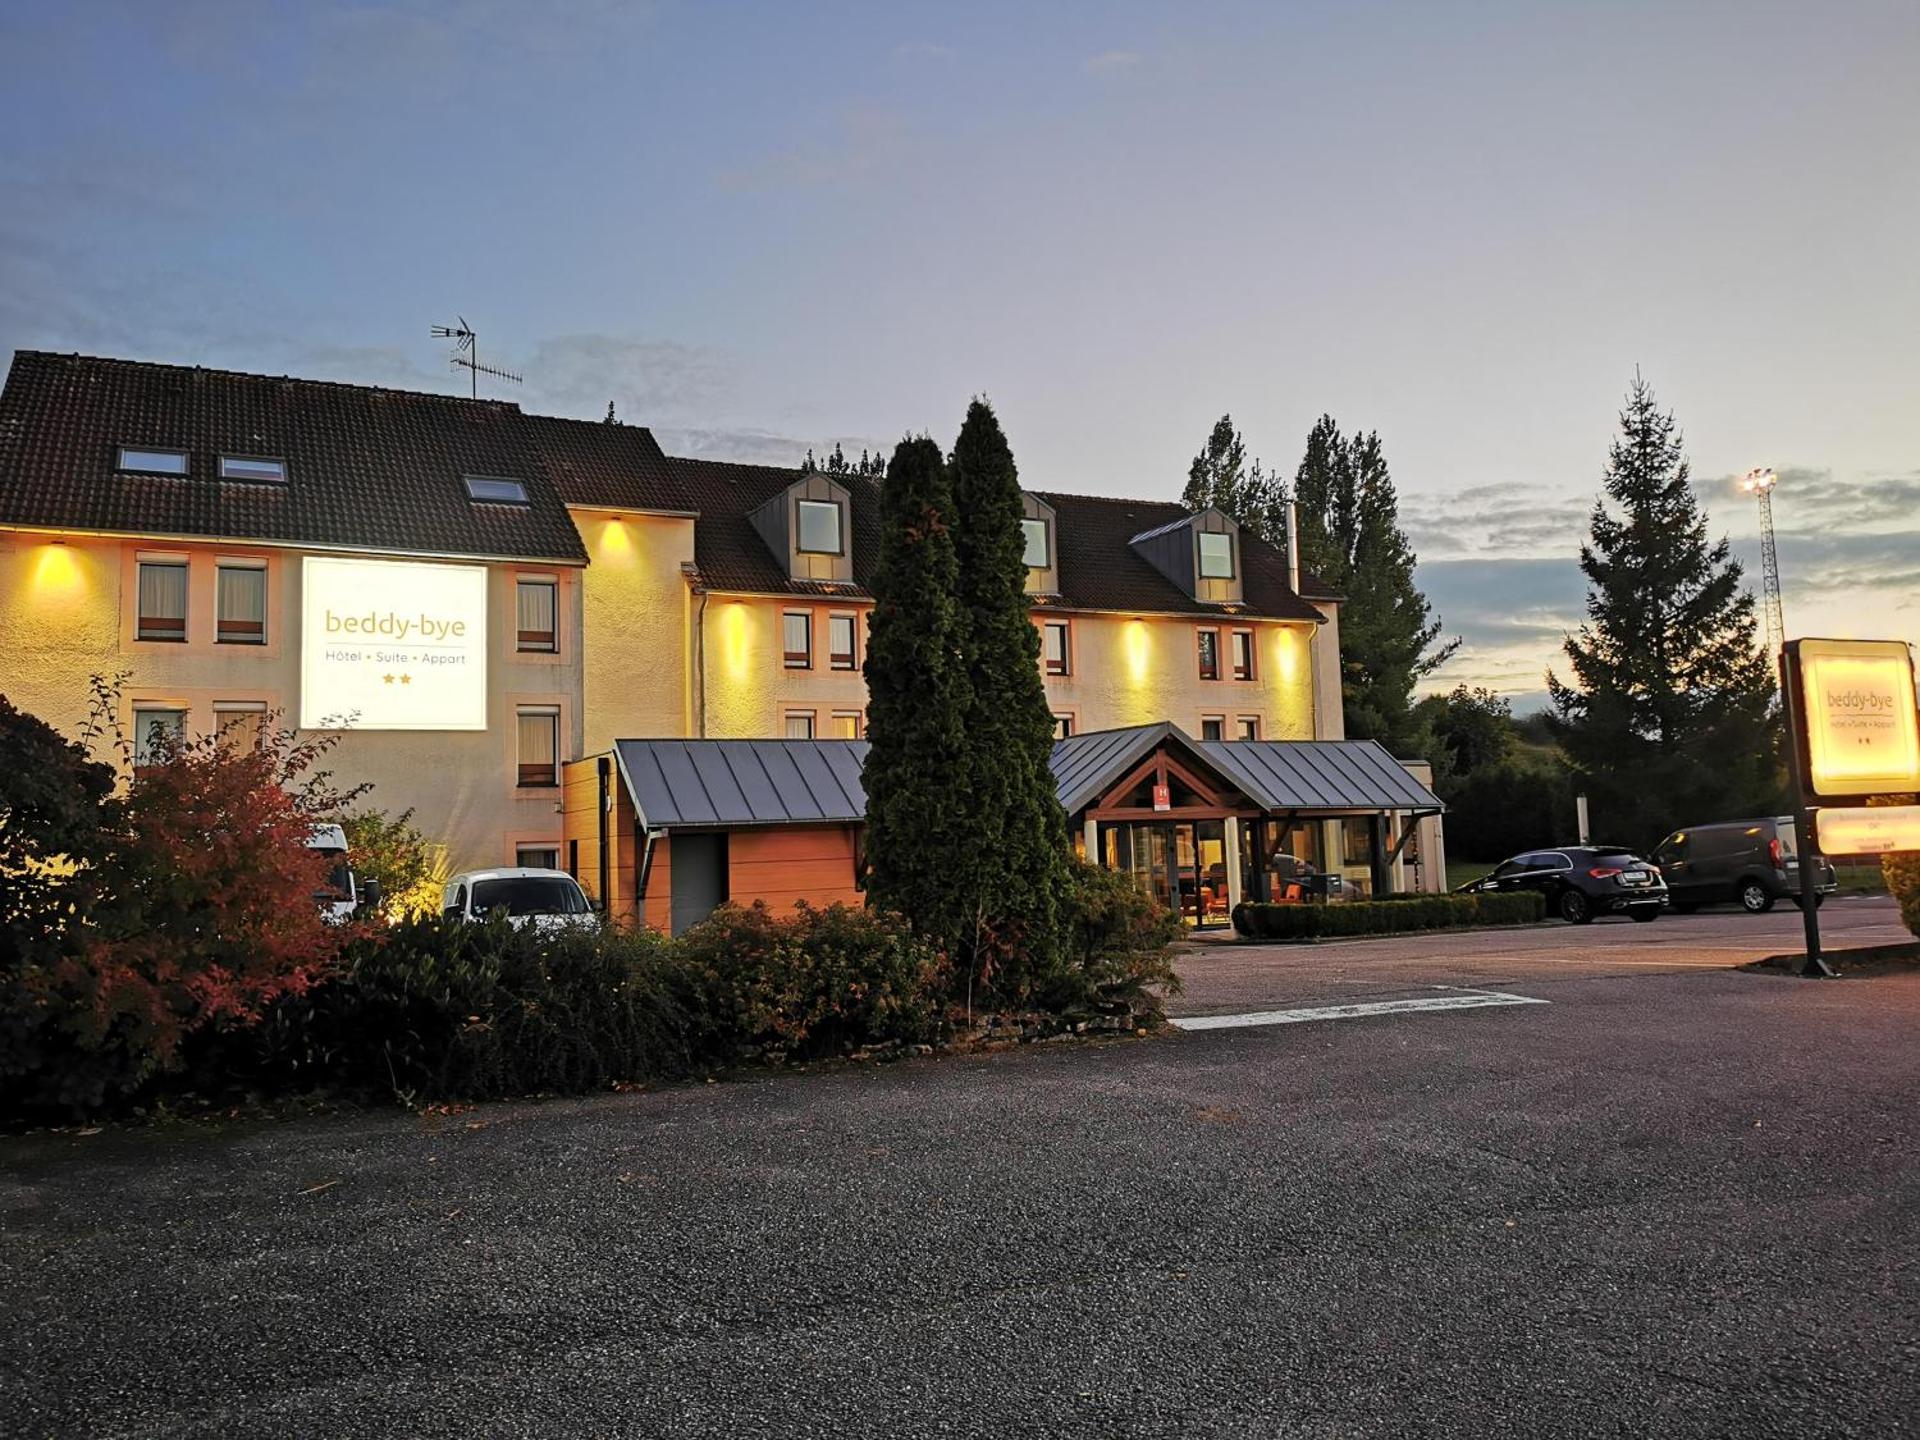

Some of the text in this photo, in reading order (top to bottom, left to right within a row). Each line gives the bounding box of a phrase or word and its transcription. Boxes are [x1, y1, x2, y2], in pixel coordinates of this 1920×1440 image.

[326, 610, 466, 640] beddy-bye
[325, 651, 466, 666] Hôtel Suite Appart
[1827, 688, 1894, 711] beddy-bye
